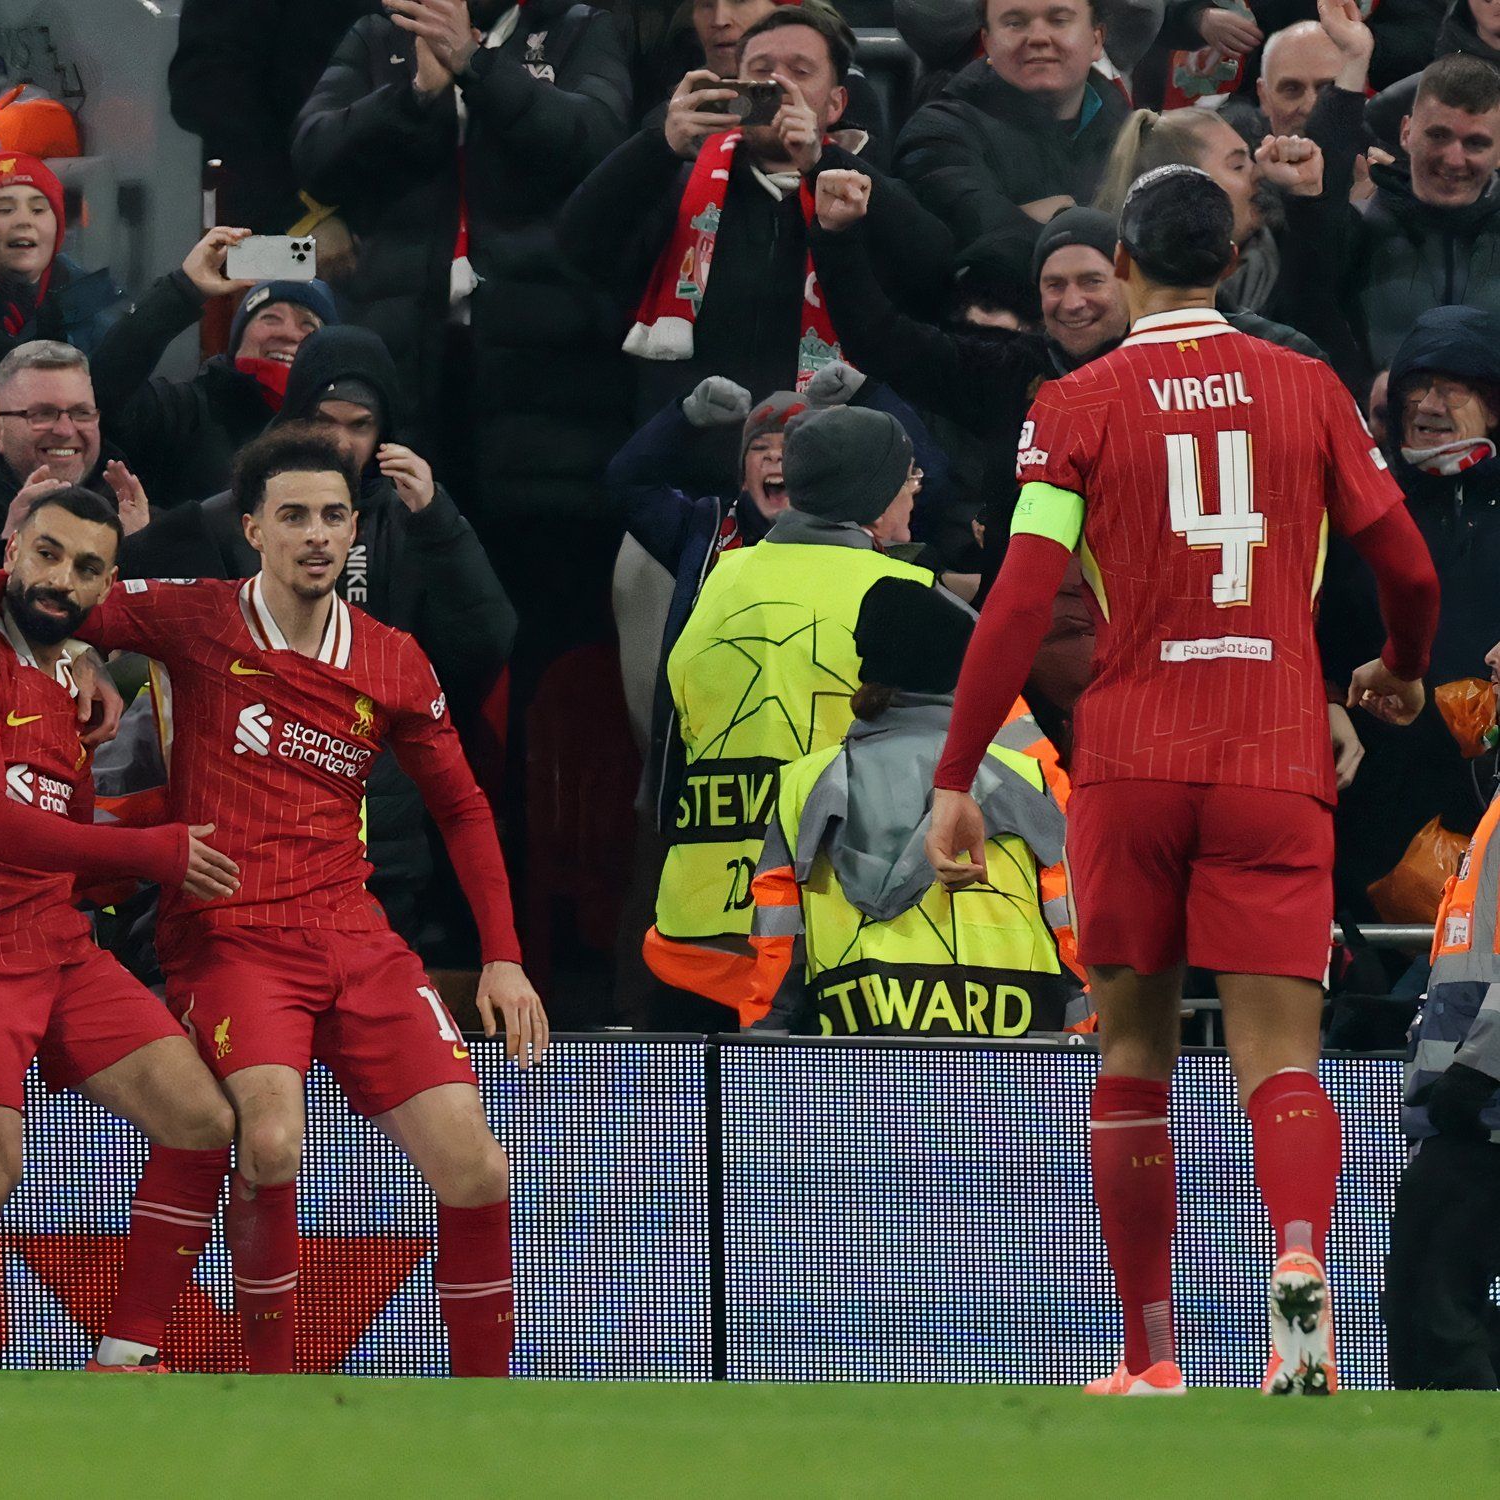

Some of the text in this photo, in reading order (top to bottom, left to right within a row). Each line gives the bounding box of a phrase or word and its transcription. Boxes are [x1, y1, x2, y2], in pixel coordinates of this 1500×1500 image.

[1148, 371, 1253, 411] VIRGIL
[1165, 429, 1268, 608] 4
[346, 544, 368, 603] NIKE
[675, 773, 777, 829] STEW
